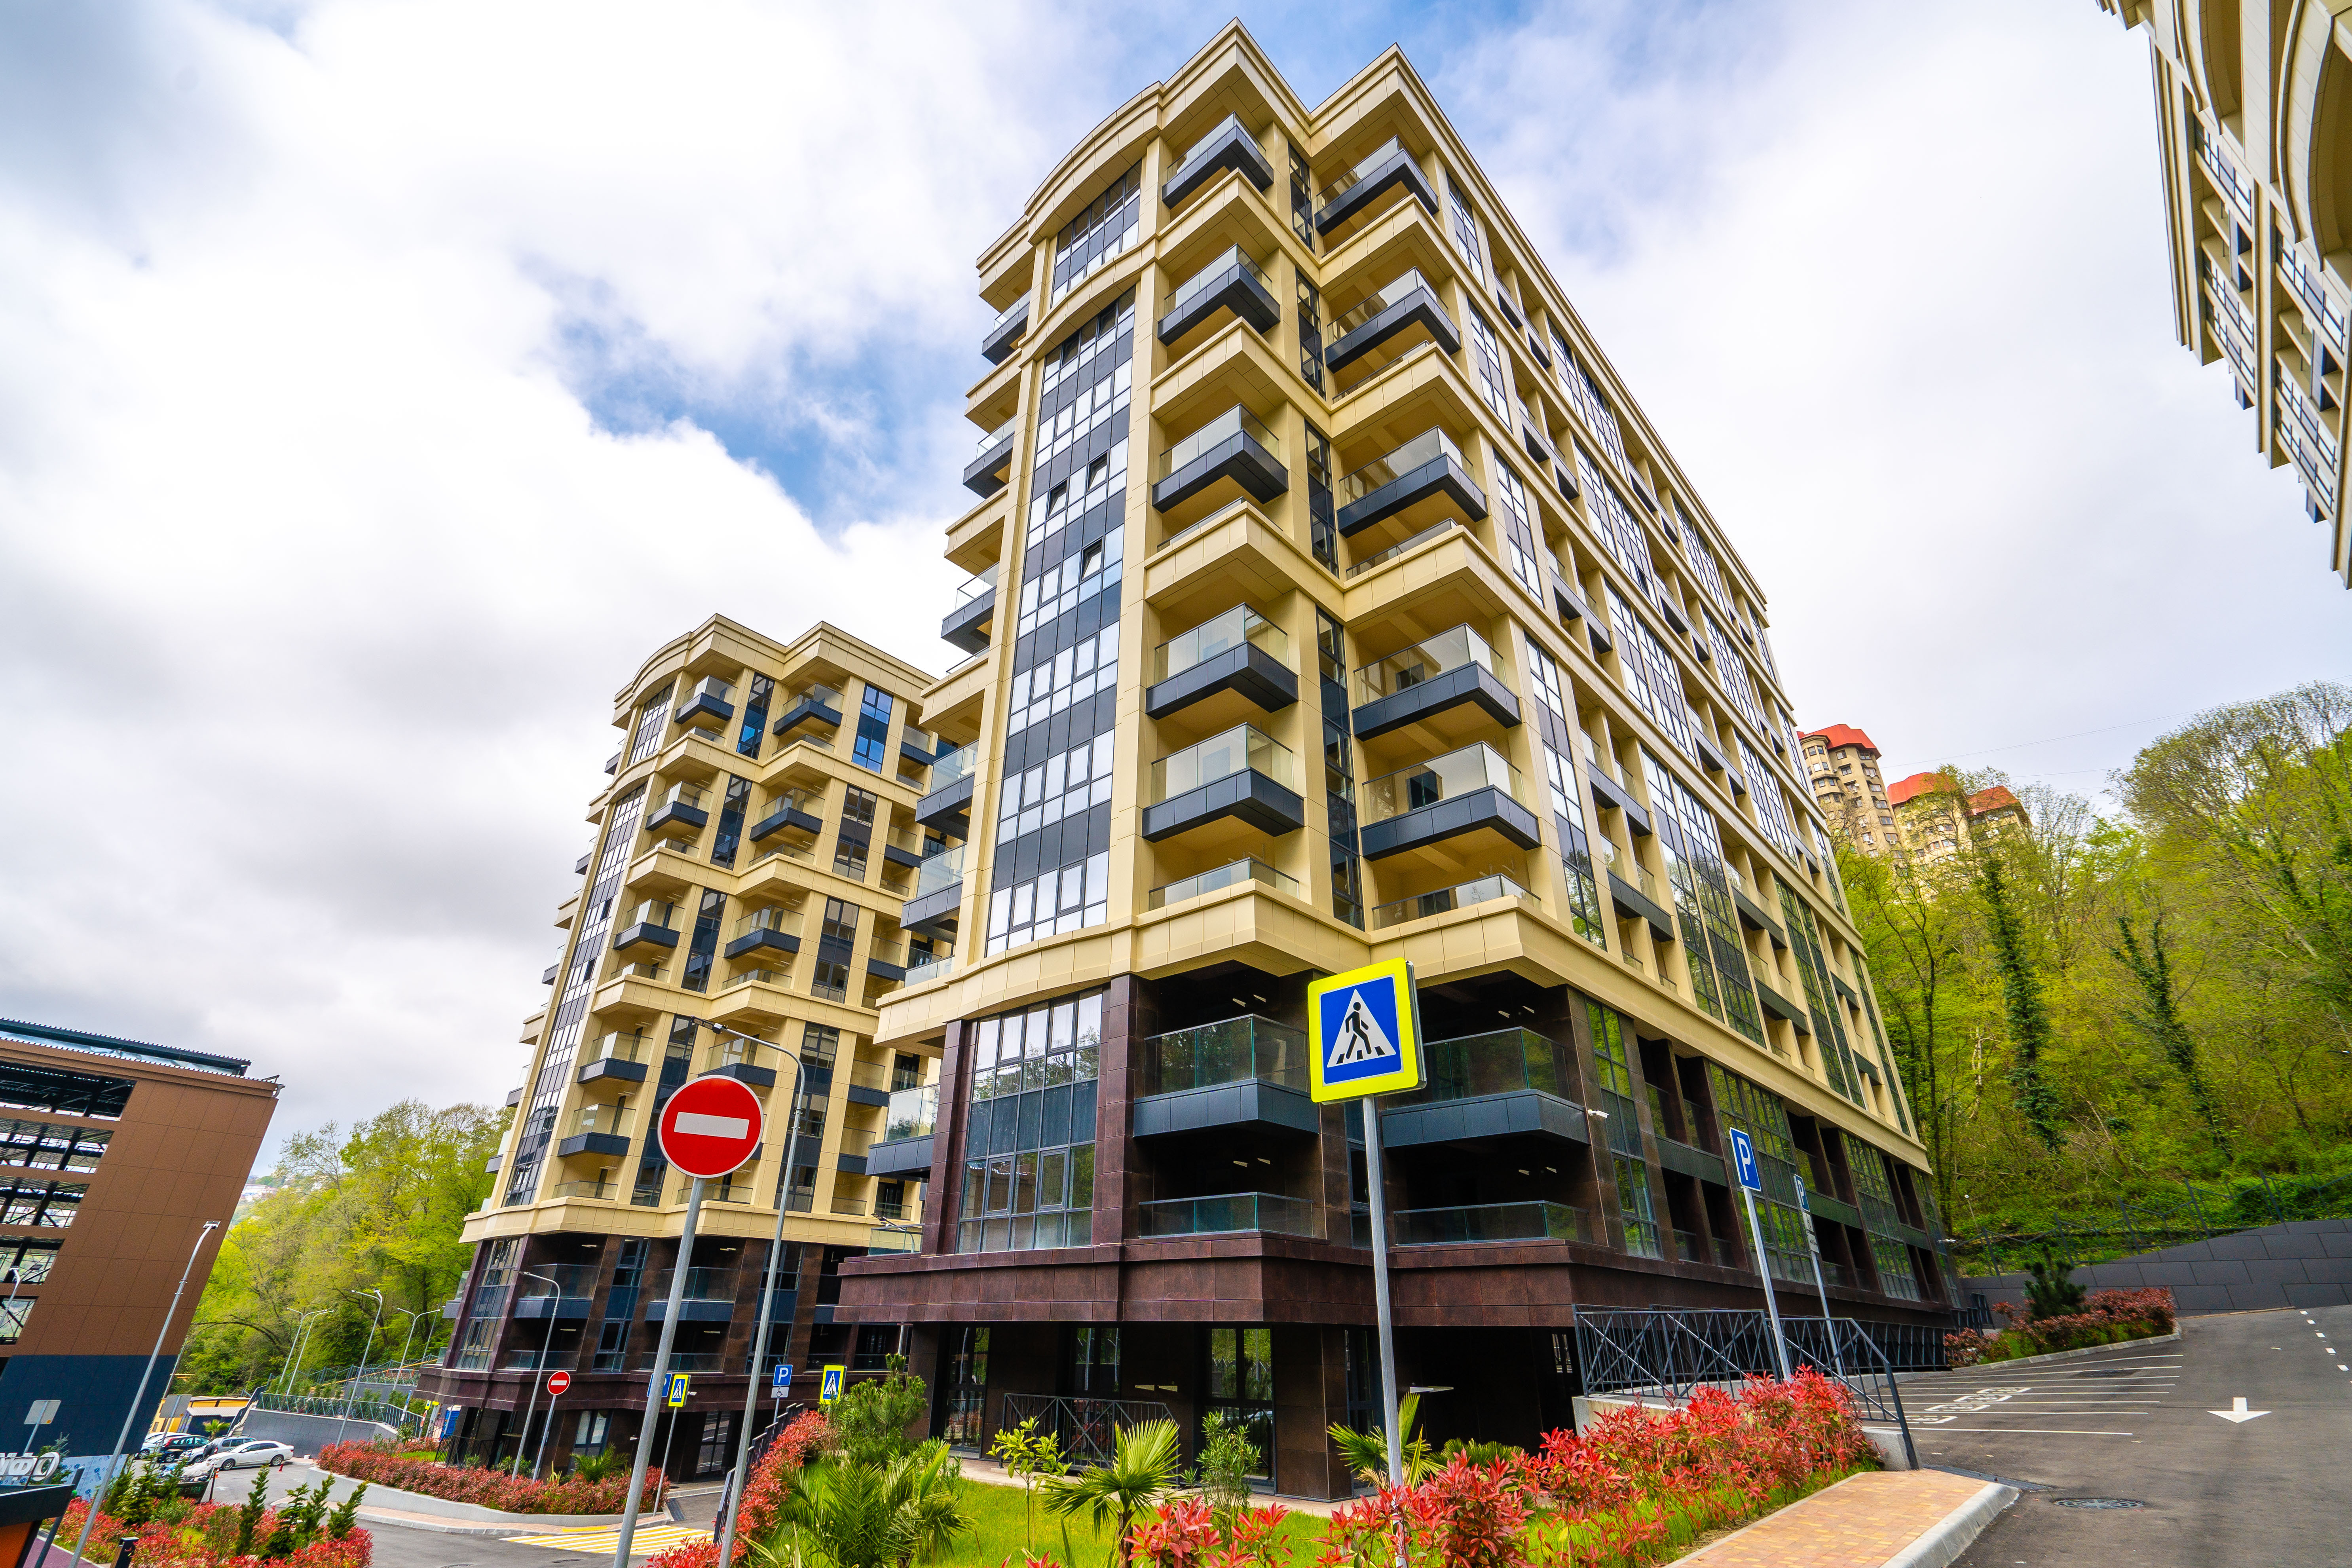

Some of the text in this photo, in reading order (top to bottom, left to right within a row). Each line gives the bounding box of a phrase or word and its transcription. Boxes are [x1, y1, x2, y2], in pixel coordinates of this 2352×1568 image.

[1737, 1137, 1751, 1181] P
[1797, 1179, 1804, 1205] P
[778, 1367, 789, 1383] P
